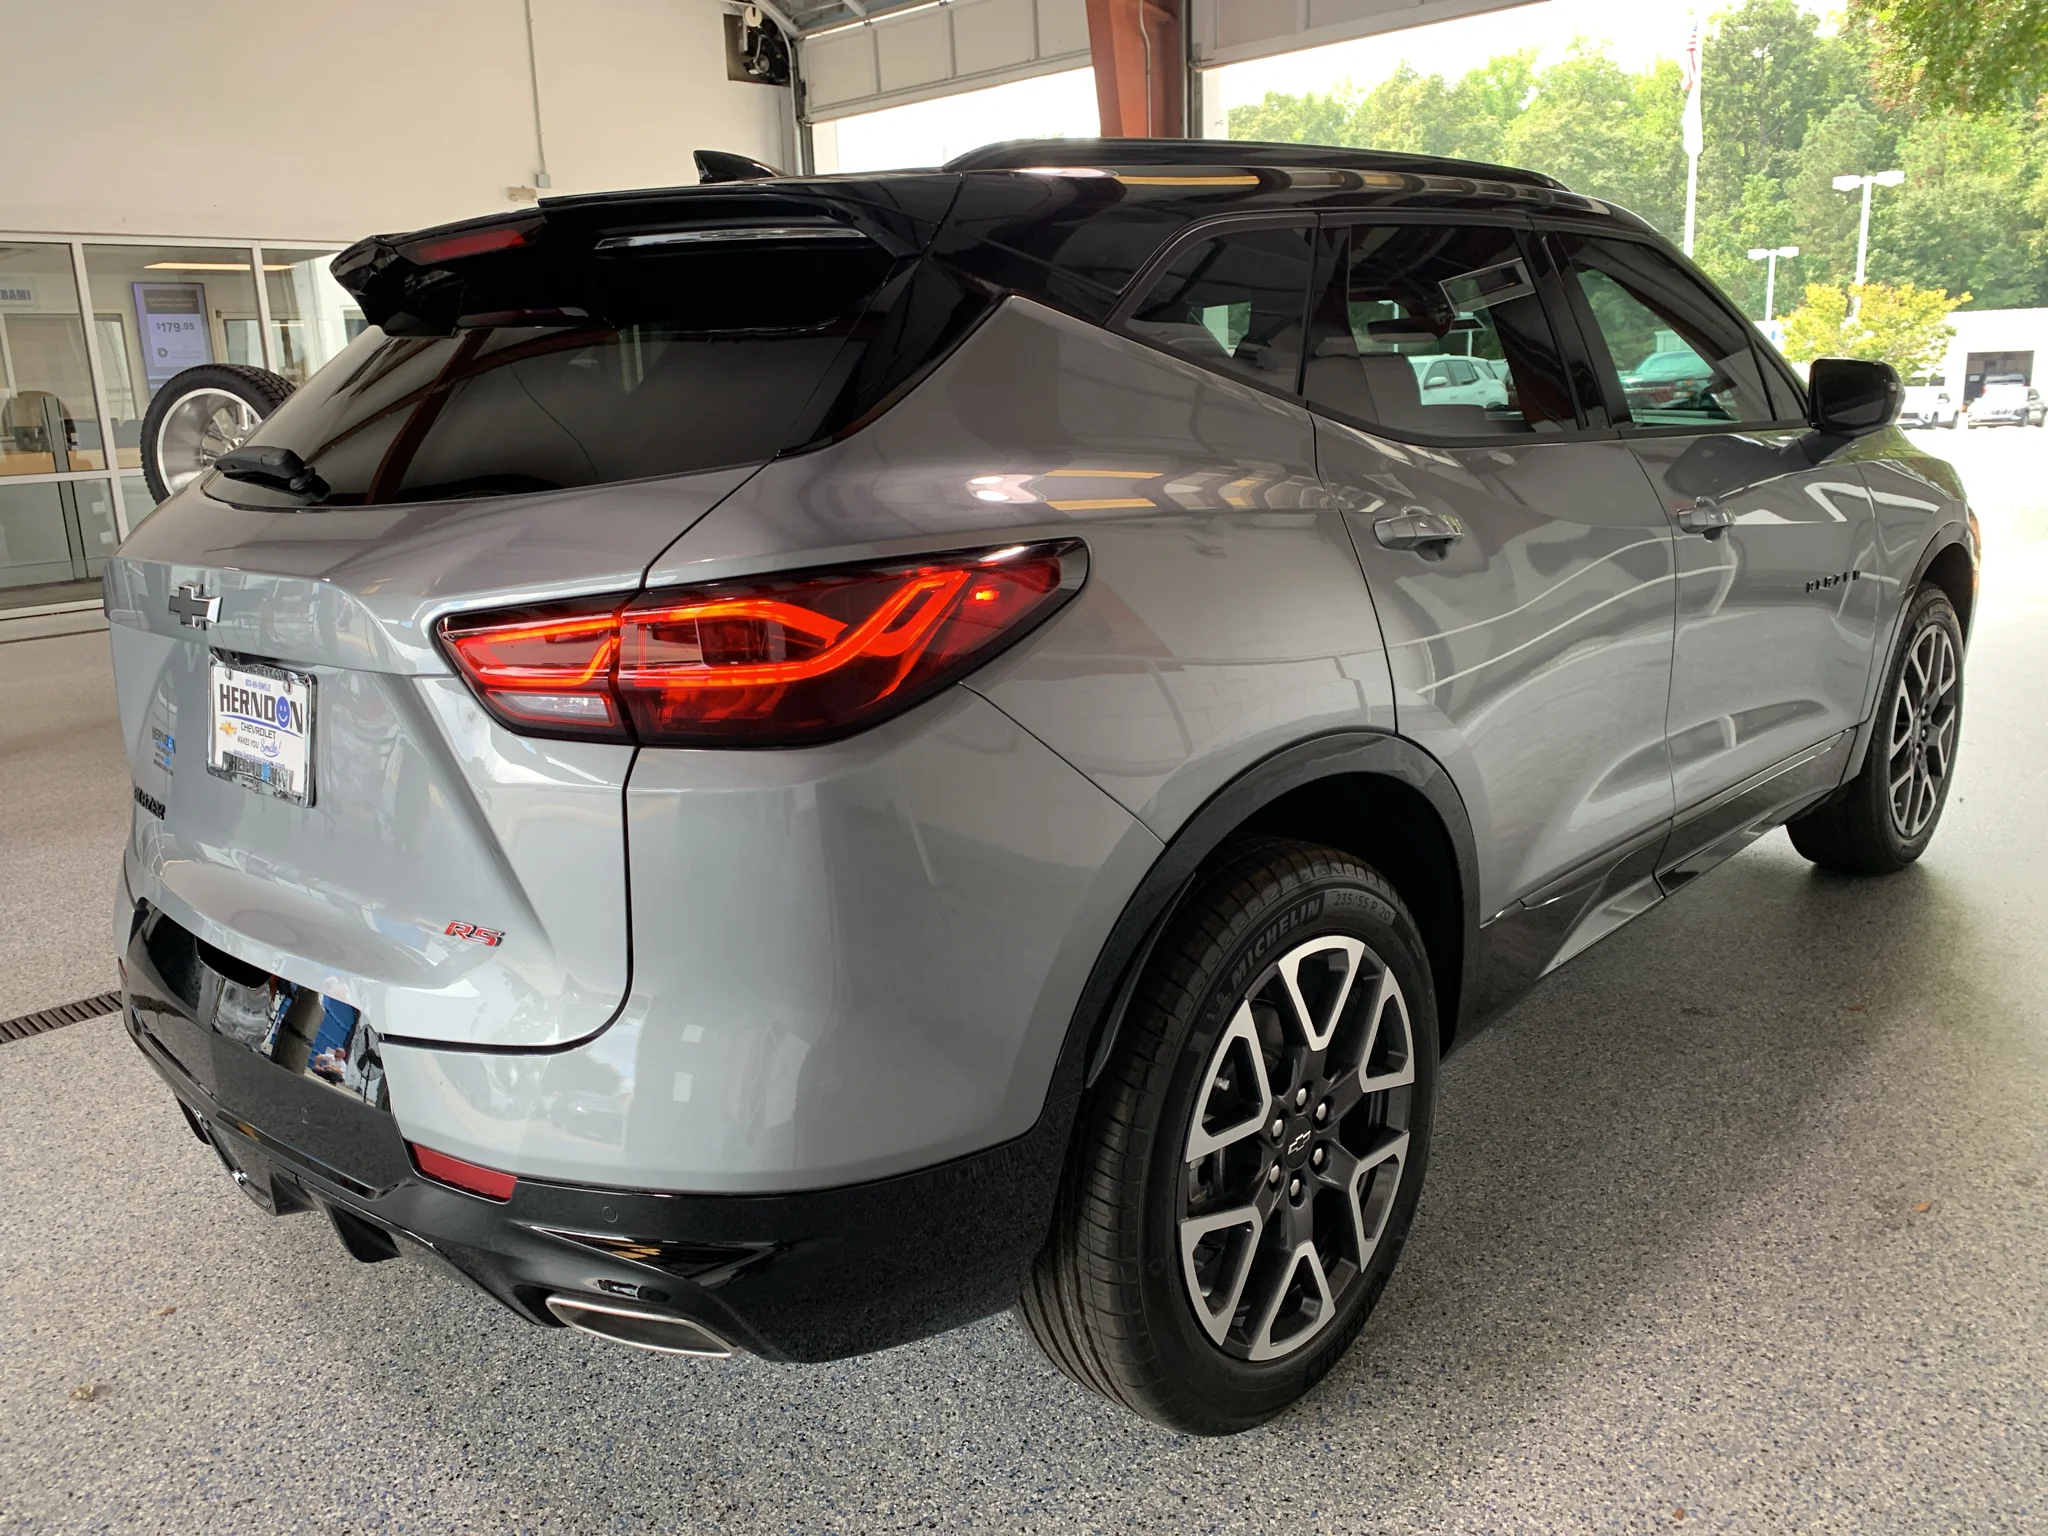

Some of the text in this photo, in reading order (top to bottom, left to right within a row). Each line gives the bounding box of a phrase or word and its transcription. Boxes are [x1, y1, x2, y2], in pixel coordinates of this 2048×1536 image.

[156, 322, 195, 332] $179.95
[219, 683, 304, 735] HERNDON
[237, 735, 282, 755] MAKES YOU Smile!
[240, 722, 277, 741] CHEVROLET
[1333, 892, 1391, 922] 235/55 R 20
[443, 920, 506, 947] RS
[1230, 897, 1321, 992] MICHELIN
